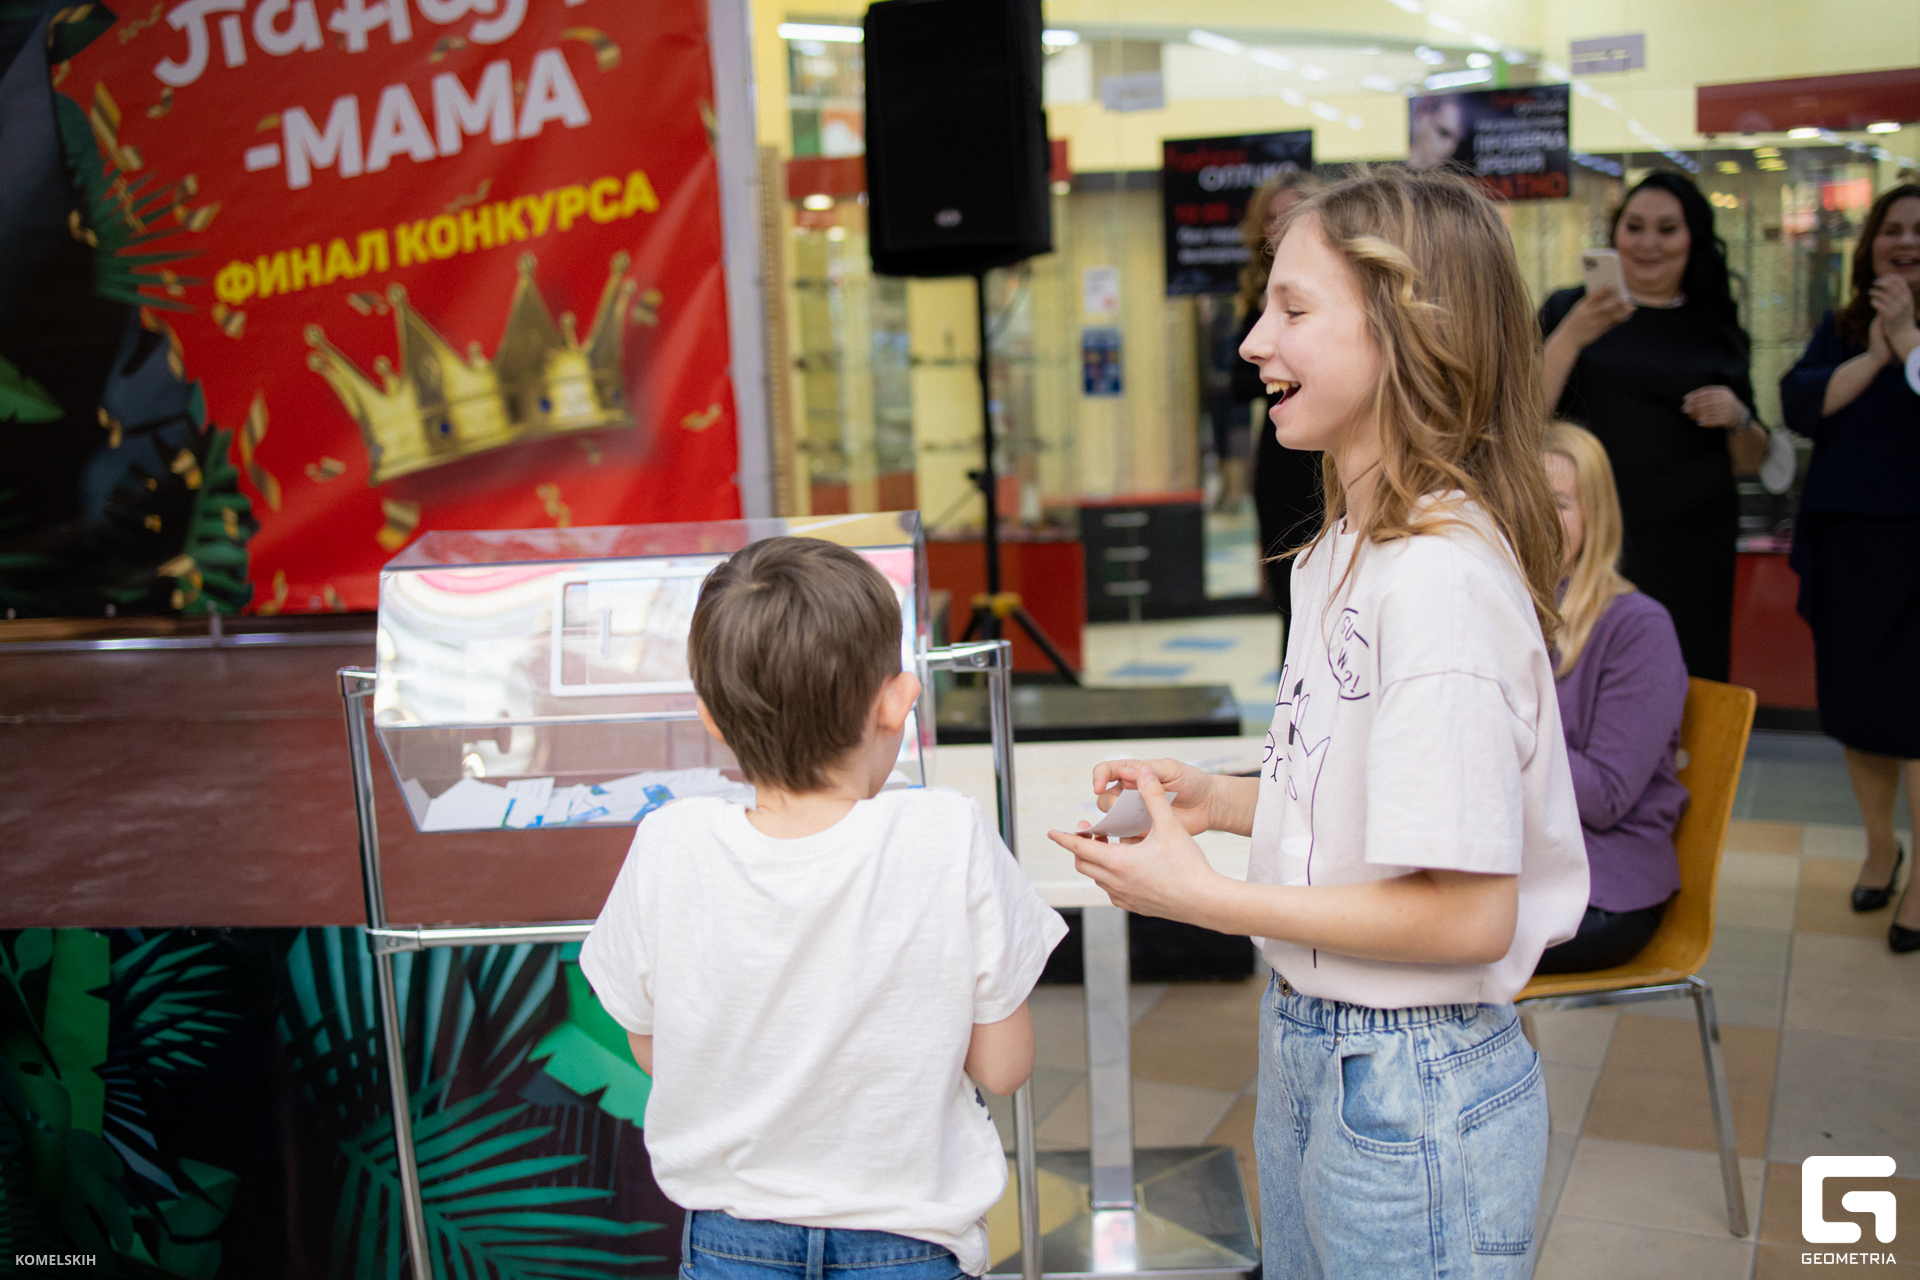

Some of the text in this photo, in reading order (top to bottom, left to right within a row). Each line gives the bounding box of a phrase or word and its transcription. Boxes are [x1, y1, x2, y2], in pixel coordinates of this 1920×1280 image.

[244, 48, 591, 190] -МАМА
[214, 169, 661, 304] ФИНАЛ КОНКУРСА
